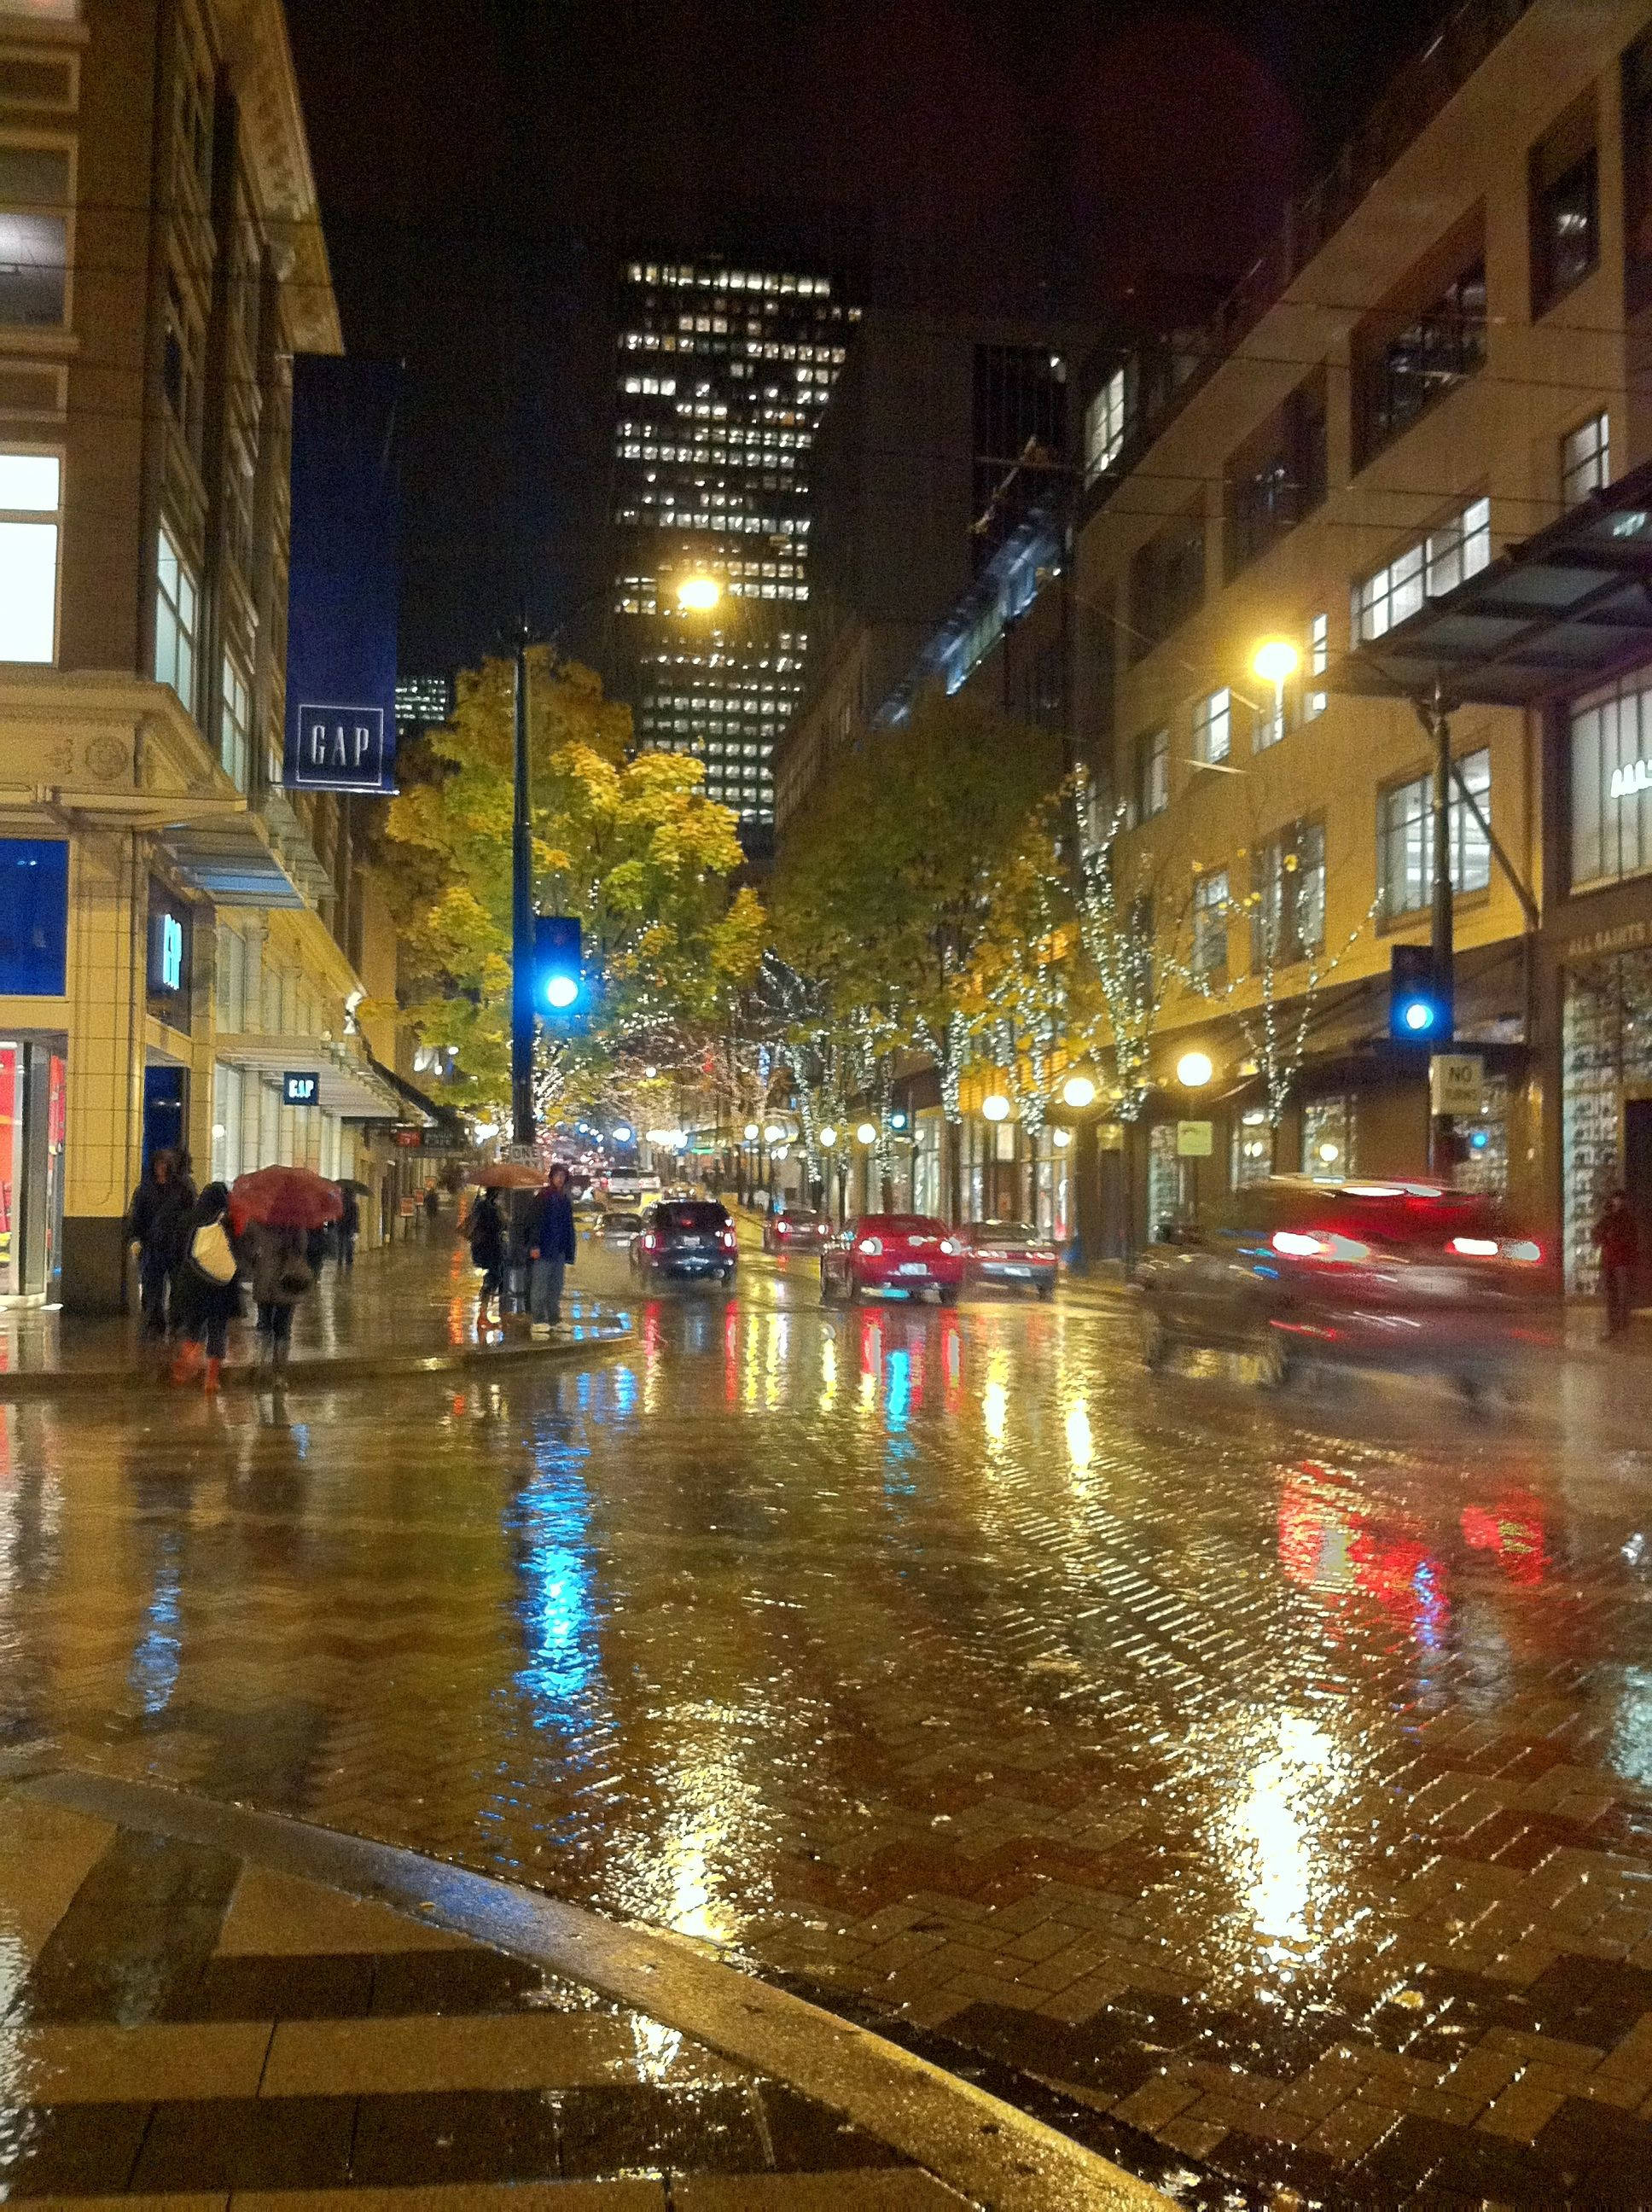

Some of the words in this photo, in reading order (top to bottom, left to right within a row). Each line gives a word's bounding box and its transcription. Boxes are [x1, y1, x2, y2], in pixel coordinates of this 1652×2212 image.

[311, 725, 369, 765] GAP
[1448, 1065, 1473, 1083] NO
[288, 1079, 314, 1098] GAP
[513, 1147, 538, 1159] ONE
